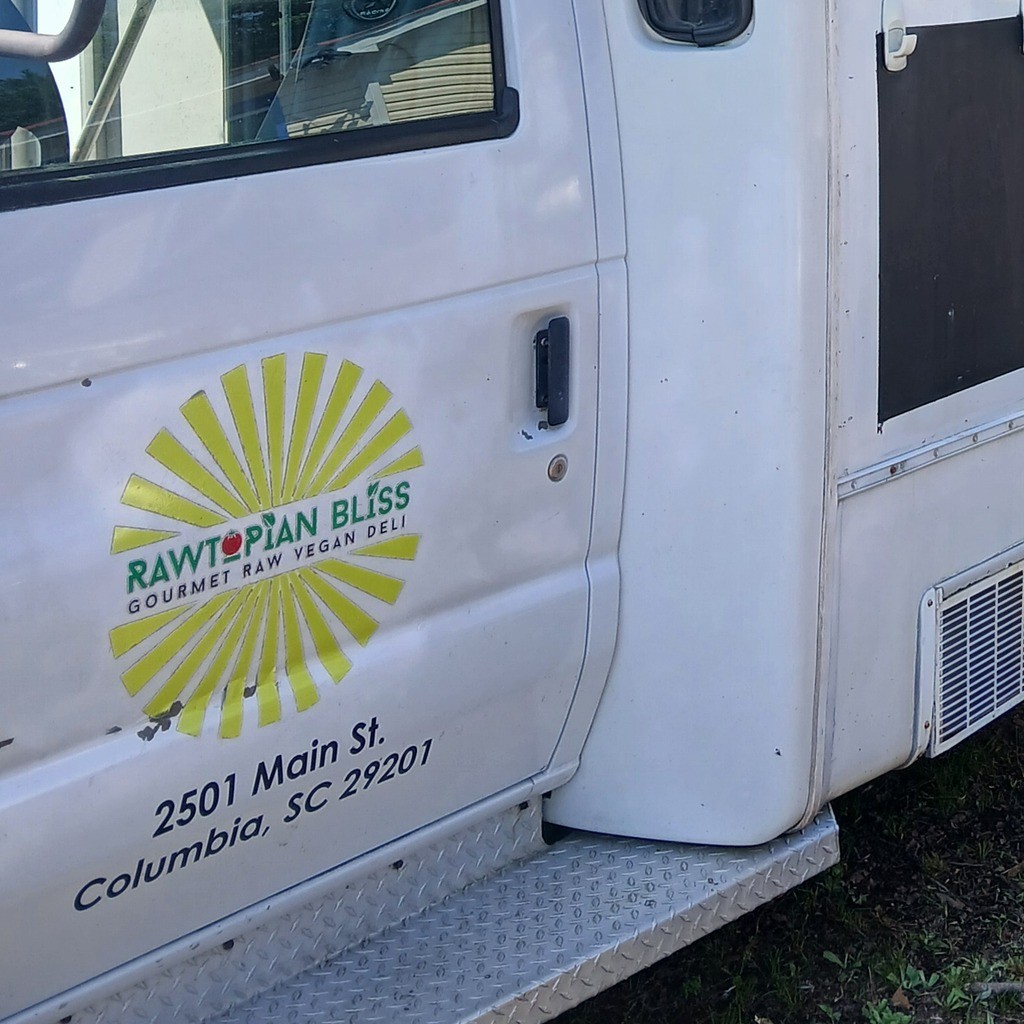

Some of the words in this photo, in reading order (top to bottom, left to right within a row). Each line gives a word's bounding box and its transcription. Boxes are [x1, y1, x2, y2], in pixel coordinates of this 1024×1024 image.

[127, 506, 318, 594] RAWTOPIAN
[331, 480, 411, 530] BLISS
[128, 570, 231, 615] GOURMET
[242, 553, 283, 579] RAW
[294, 531, 355, 561] VEGAN
[367, 514, 407, 539] DELI
[73, 813, 271, 912] Columbia,
[283, 780, 333, 824] SC
[338, 738, 434, 801] 29201
[152, 772, 237, 839] 2501
[250, 738, 339, 797] Main
[349, 716, 386, 756] St.
